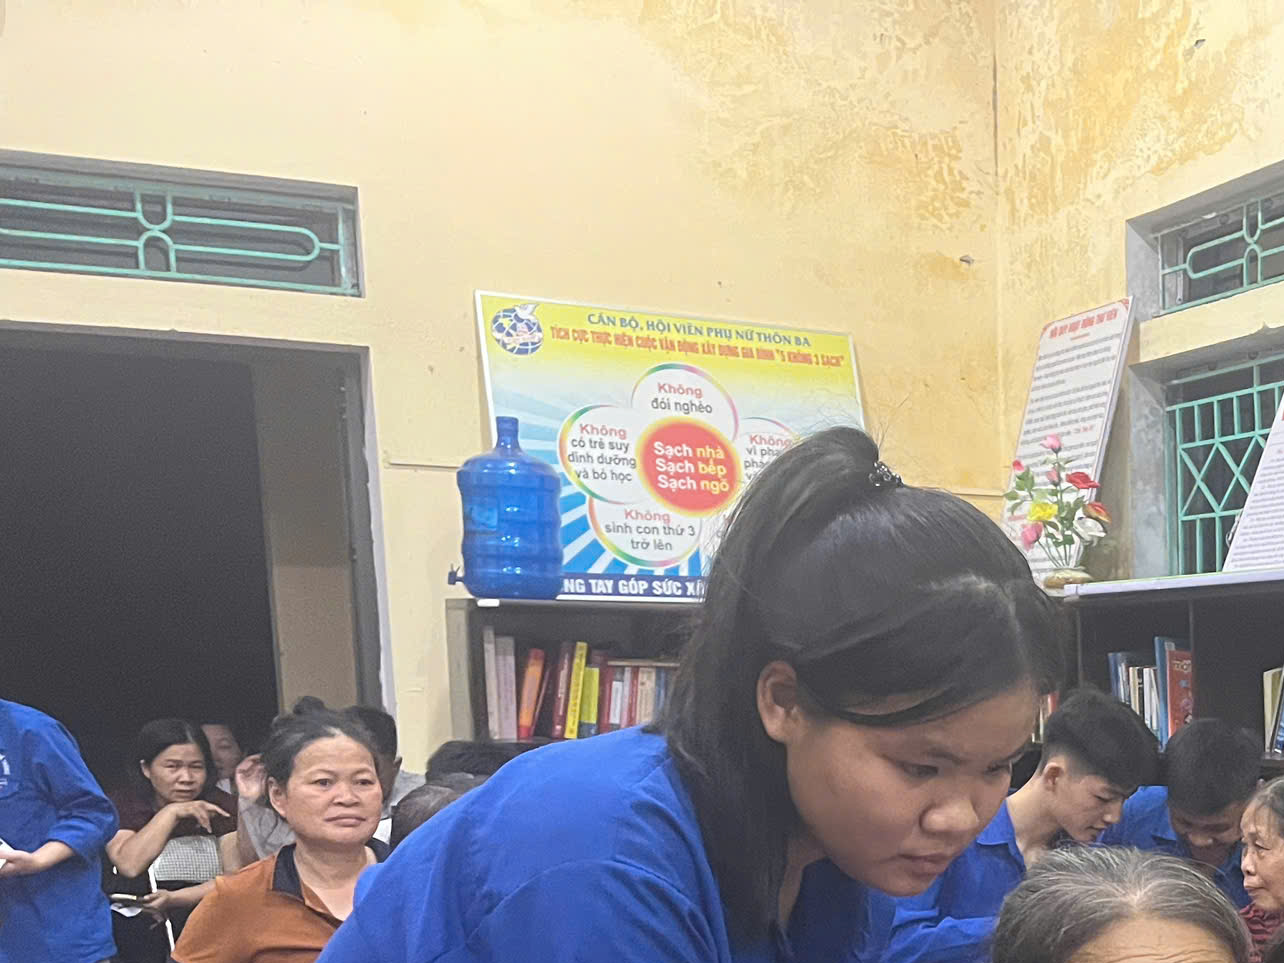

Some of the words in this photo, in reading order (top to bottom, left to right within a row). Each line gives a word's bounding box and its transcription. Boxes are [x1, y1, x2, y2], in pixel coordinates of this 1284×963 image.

[646, 319, 671, 334] HỘI
[674, 322, 704, 336] VIÊN
[706, 327, 733, 341] PHỤ
[795, 337, 811, 347] BA
[657, 382, 704, 399] Không
[651, 397, 672, 411] đói
[674, 399, 713, 415] nghèo
[579, 423, 627, 440] Không
[571, 437, 586, 448] có
[608, 442, 630, 454] suy
[749, 434, 793, 449] Không
[653, 441, 693, 459] Sạch
[696, 445, 725, 460] nhà
[567, 451, 594, 464] dinh
[596, 452, 637, 469] dưỡng
[655, 458, 695, 476] Sạch
[698, 459, 727, 478] bếp
[575, 469, 589, 479] và
[610, 470, 633, 484] học
[657, 475, 697, 492] Sạch
[624, 509, 671, 526] Không
[604, 522, 632, 535] sinh
[636, 526, 660, 536] con
[662, 524, 685, 536] thứ
[687, 525, 696, 537] 3
[654, 538, 673, 551] lên
[588, 579, 614, 594] TAY
[618, 577, 649, 595] GÓP
[652, 578, 682, 596] SỨC
